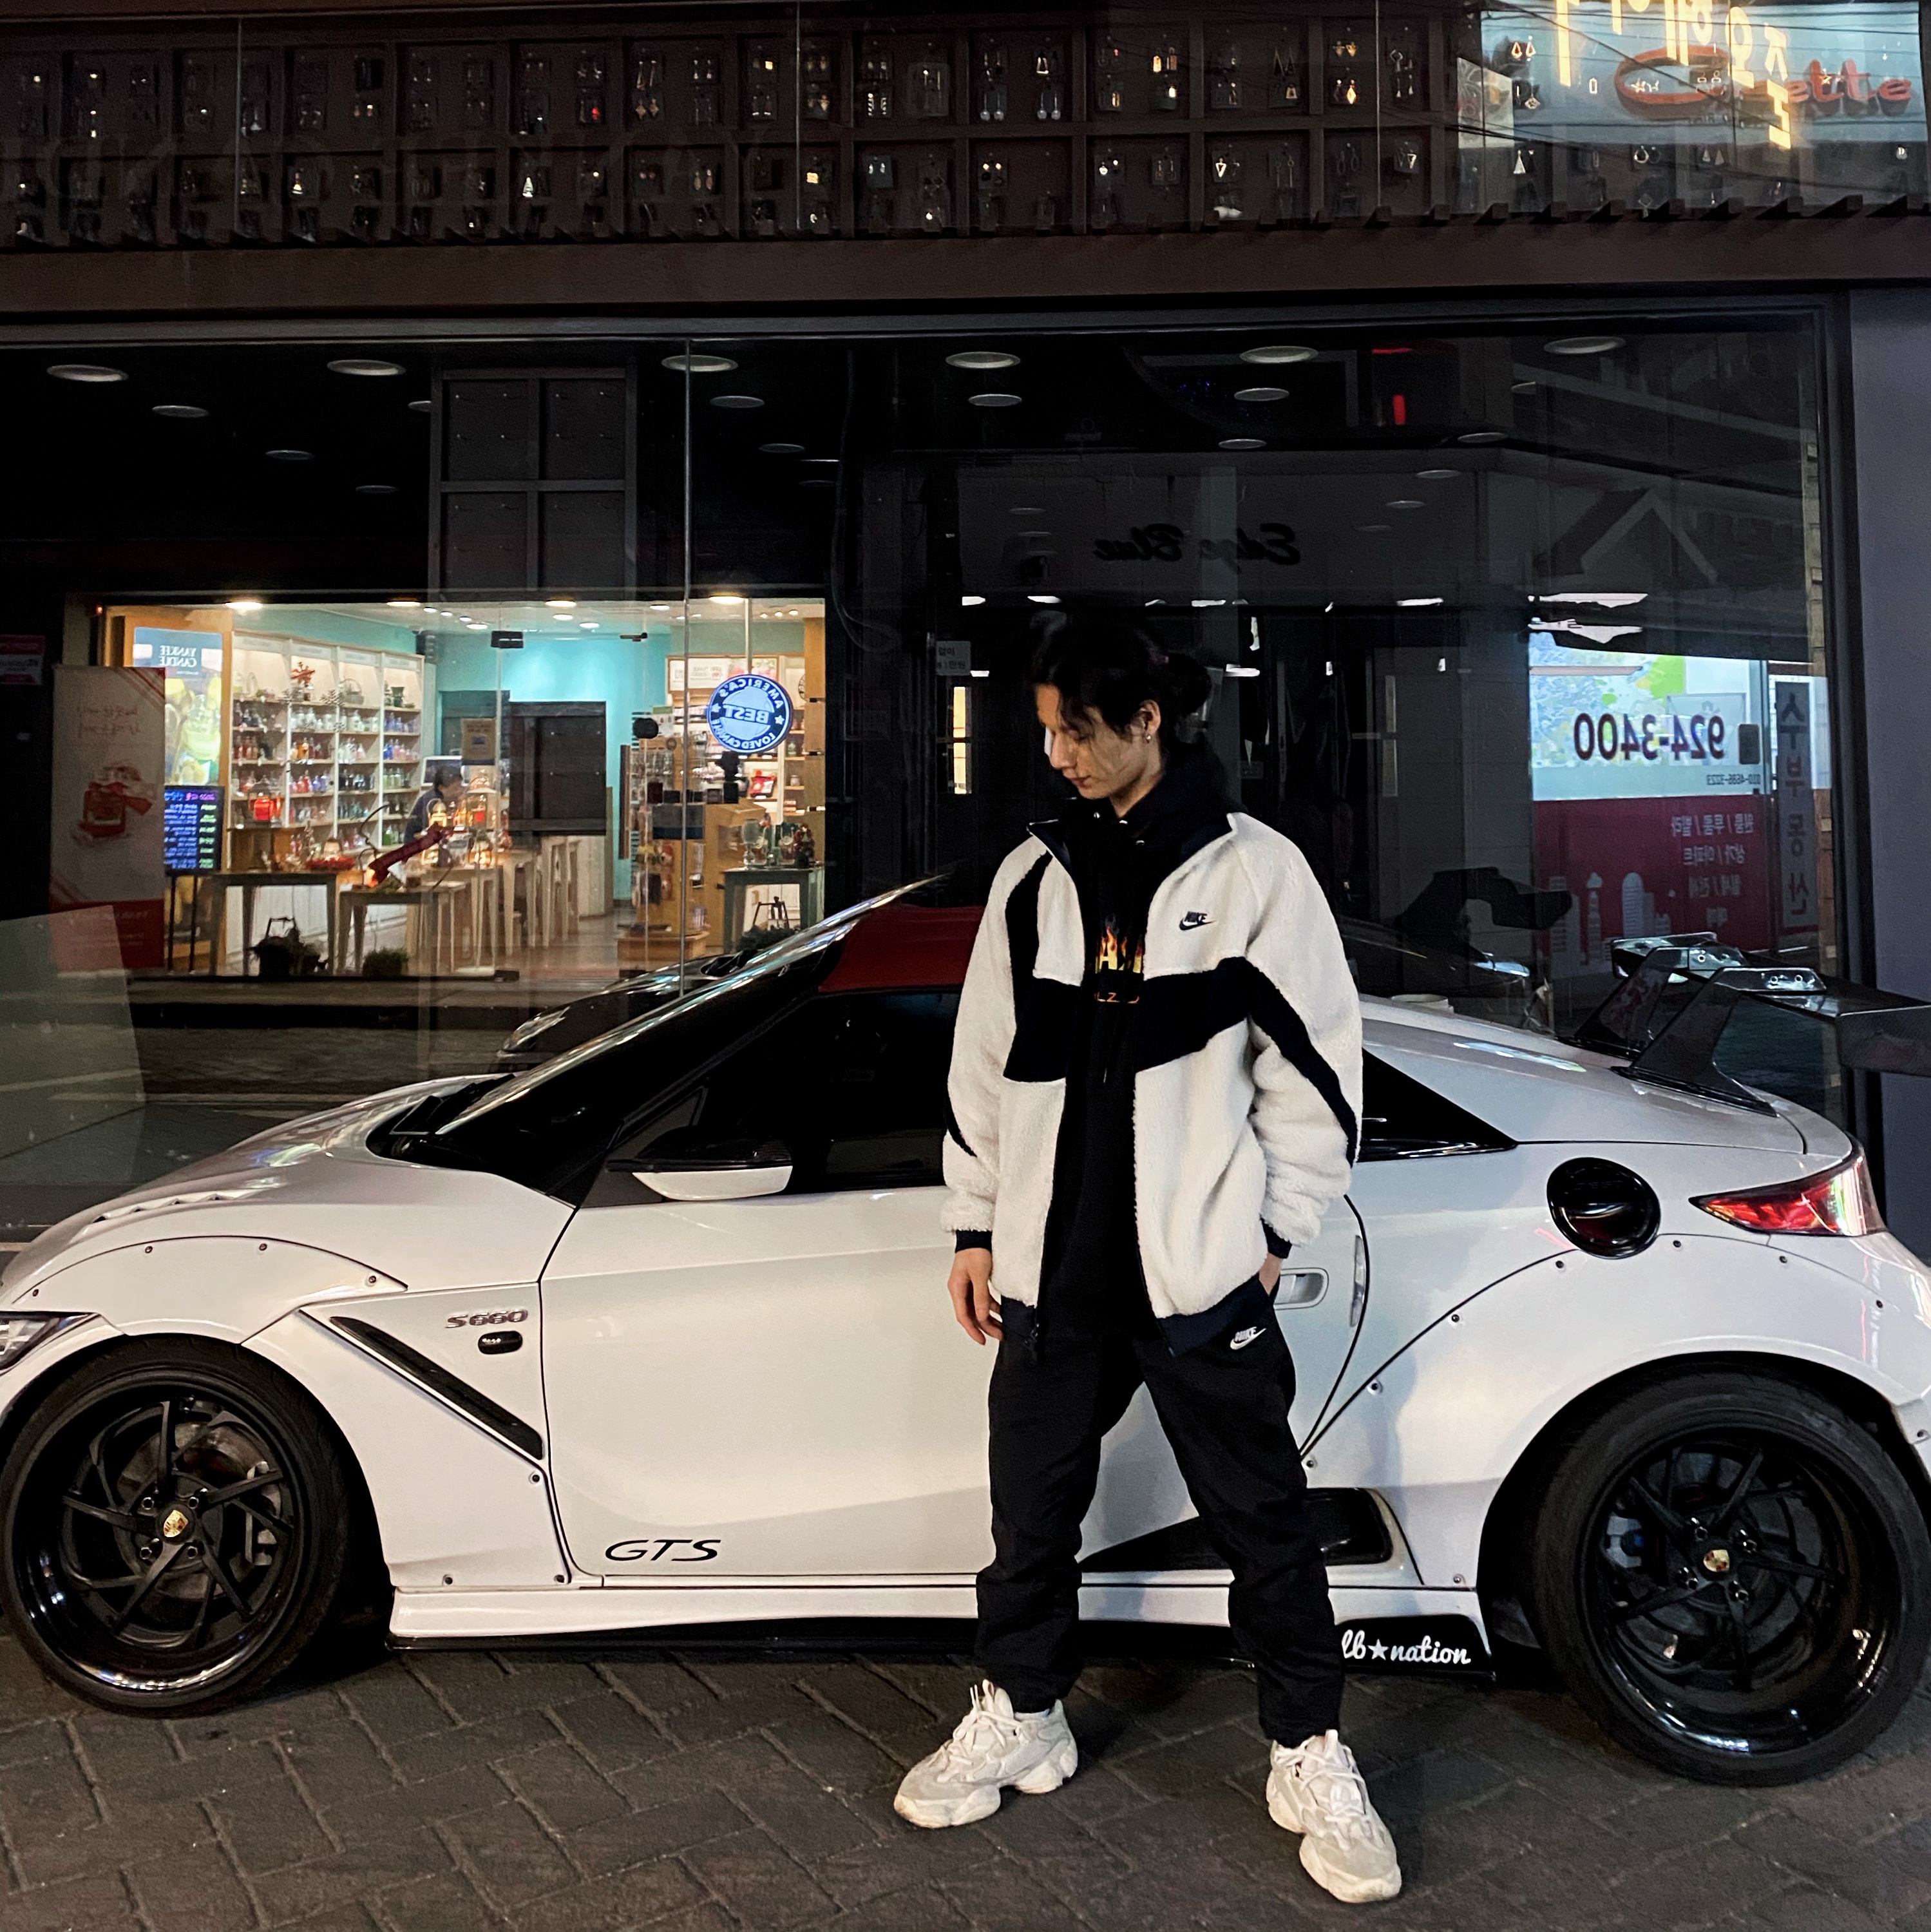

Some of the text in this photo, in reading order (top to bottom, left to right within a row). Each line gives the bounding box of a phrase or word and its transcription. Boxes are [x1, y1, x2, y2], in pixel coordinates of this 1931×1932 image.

[445, 1309, 528, 1328] S660
[605, 1539, 721, 1561] GTS
[1390, 1635, 1471, 1665] nation
